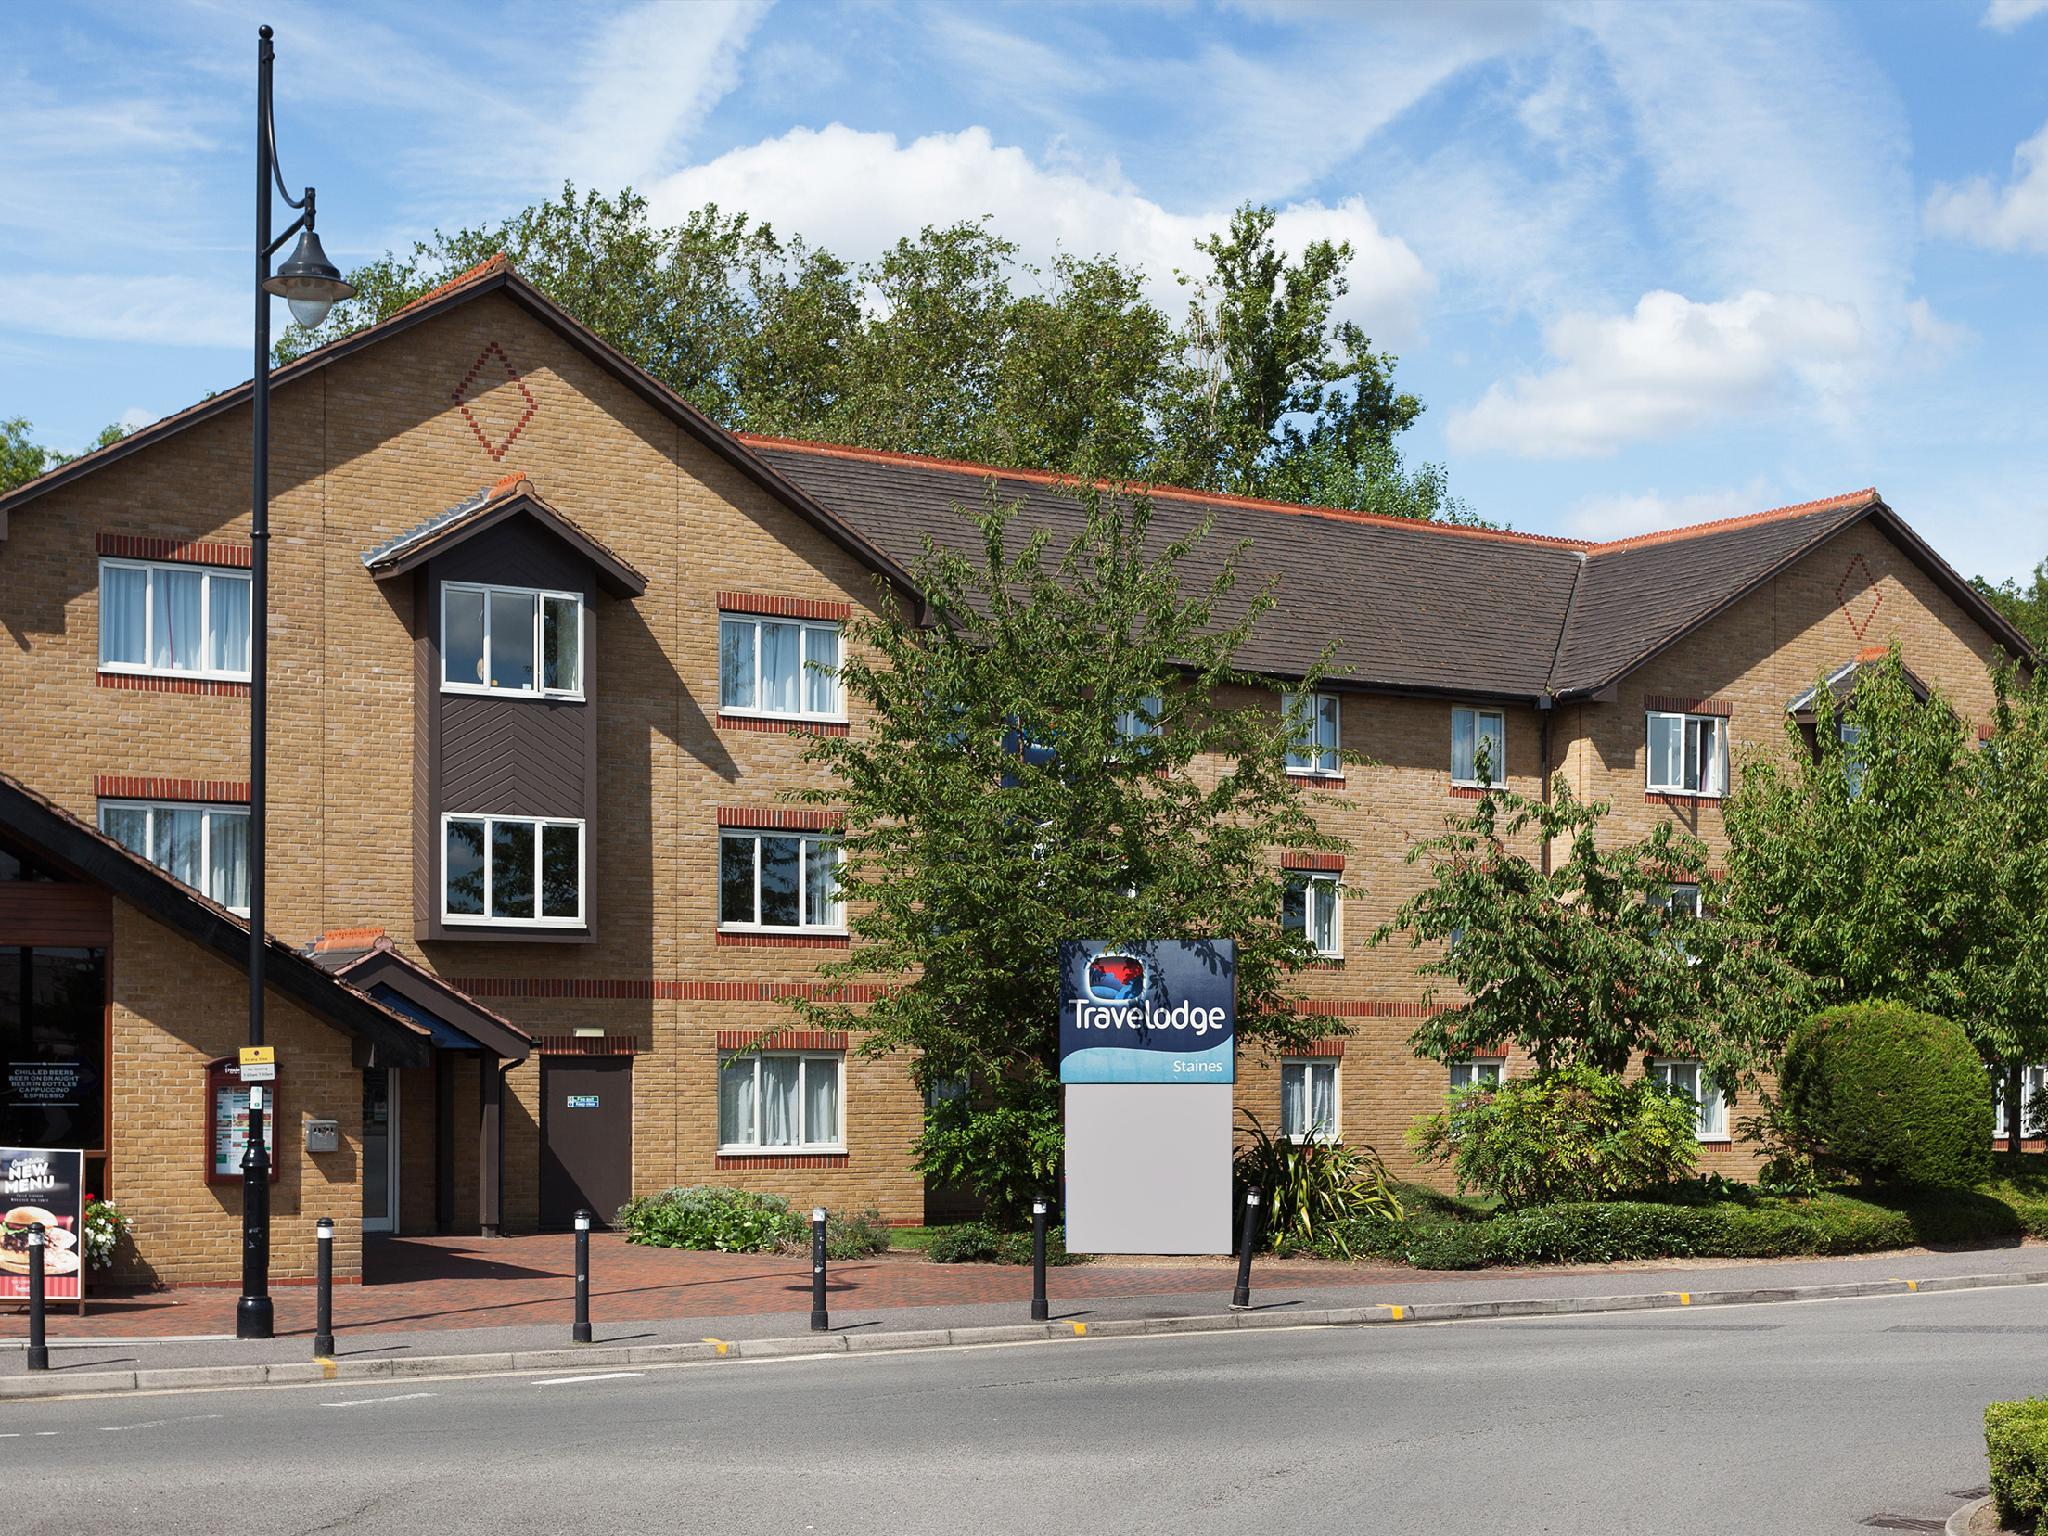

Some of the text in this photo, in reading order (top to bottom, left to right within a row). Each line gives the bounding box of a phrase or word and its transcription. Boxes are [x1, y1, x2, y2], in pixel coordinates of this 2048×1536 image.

[1068, 999, 1226, 1036] Travelodge
[1173, 1060, 1223, 1073] Staines
[8, 1162, 49, 1181] NEW
[4, 1175, 55, 1194] MENU
